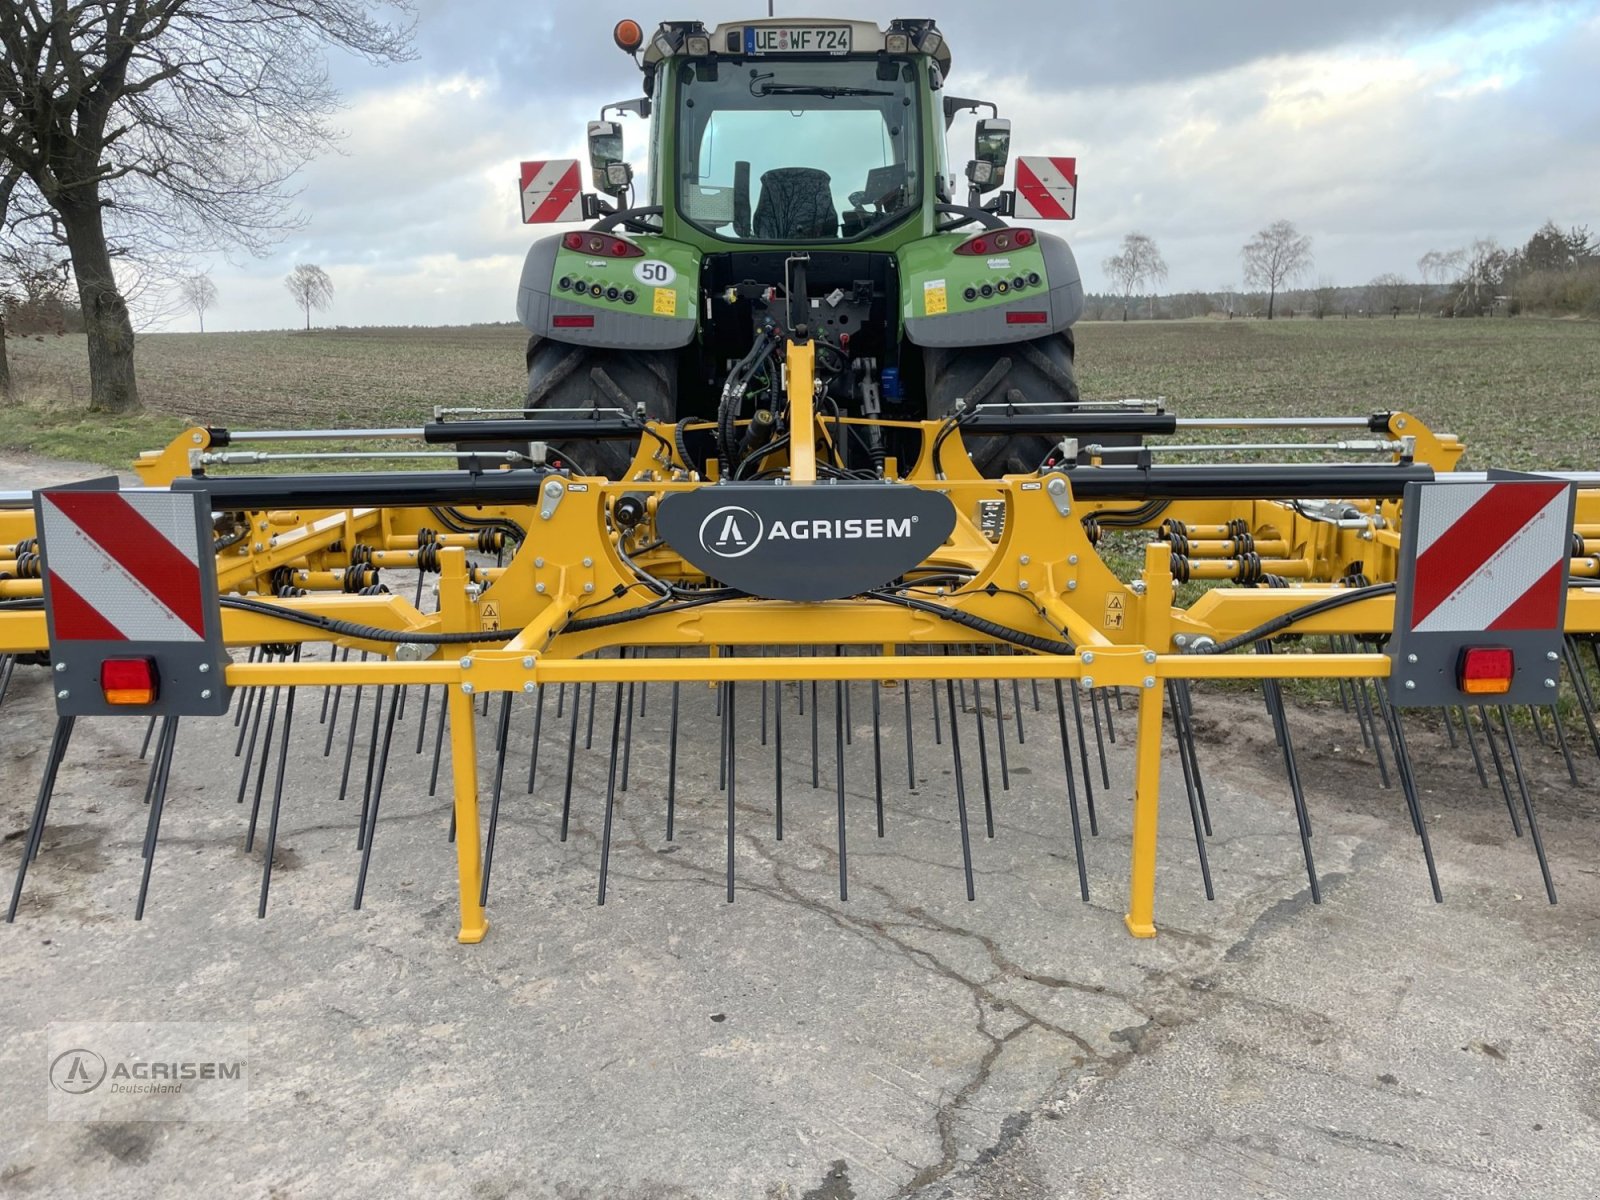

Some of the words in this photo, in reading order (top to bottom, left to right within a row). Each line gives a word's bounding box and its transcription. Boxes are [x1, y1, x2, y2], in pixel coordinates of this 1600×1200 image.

[756, 31, 778, 49] UE
[790, 31, 812, 49] WF
[816, 31, 847, 49] 724
[642, 263, 667, 281] 50
